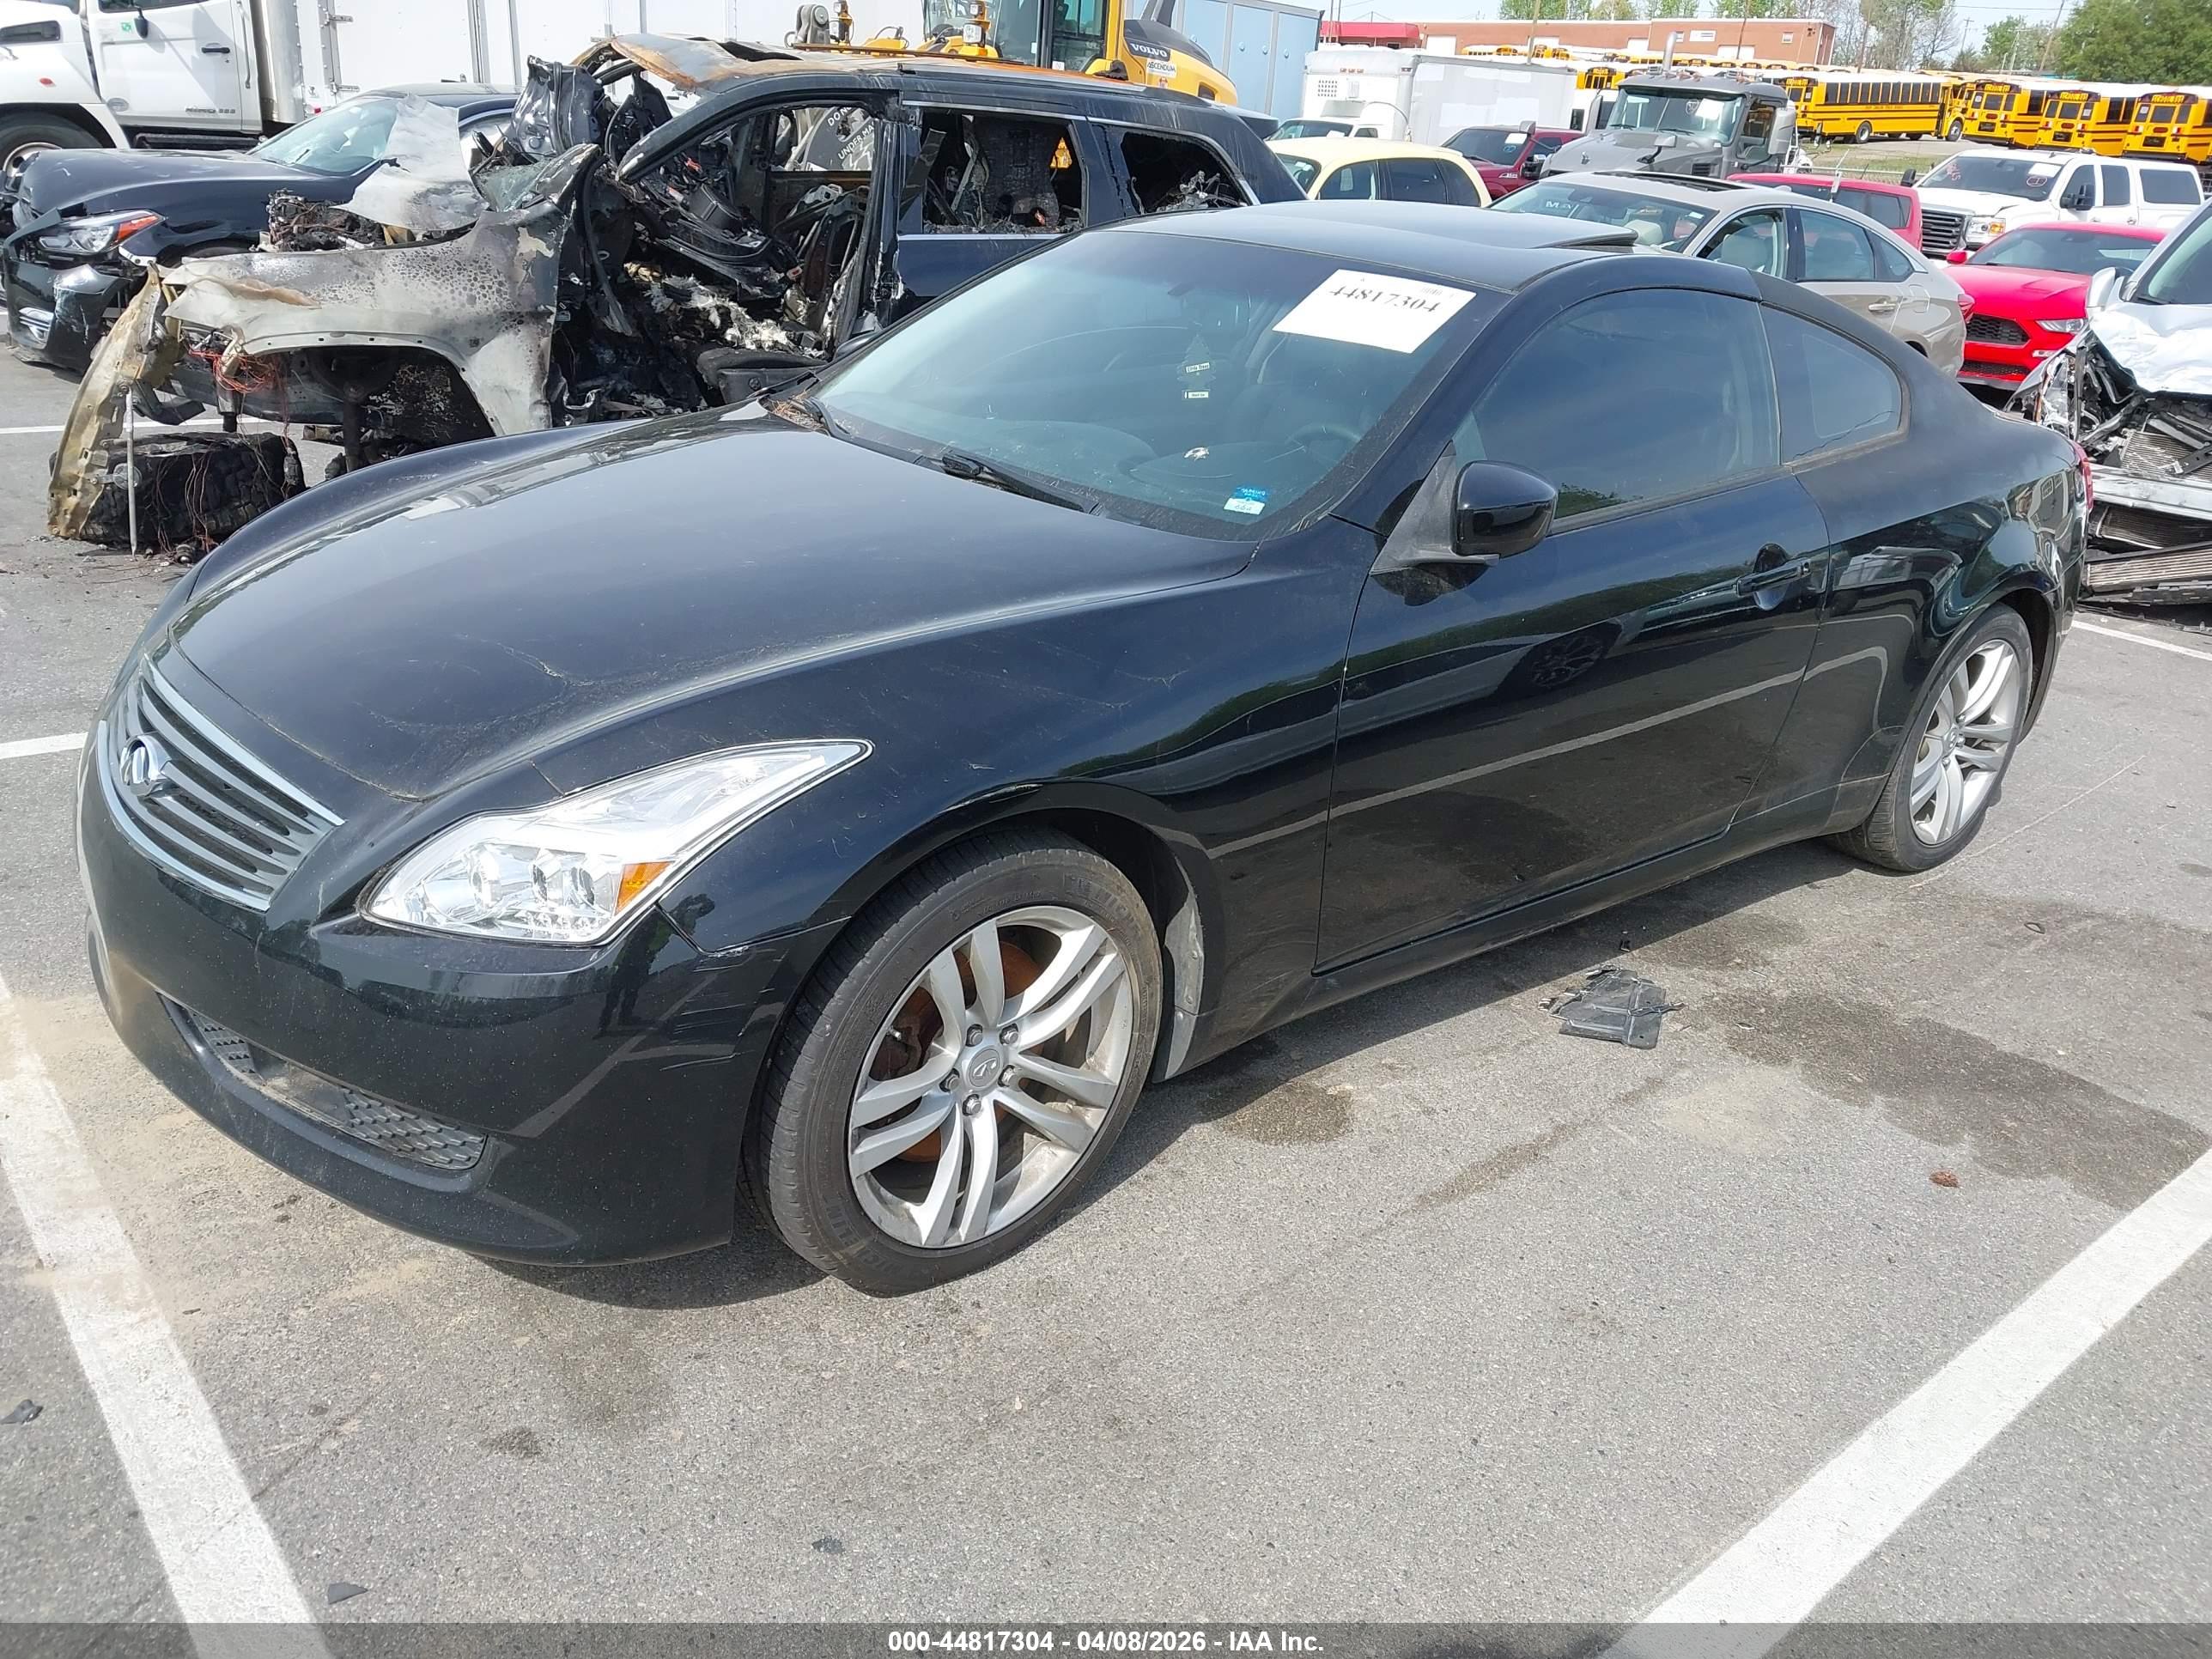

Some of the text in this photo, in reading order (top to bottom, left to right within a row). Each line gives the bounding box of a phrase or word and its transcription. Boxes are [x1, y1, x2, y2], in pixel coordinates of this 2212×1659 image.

[1130, 43, 1168, 58] VOLVO
[1147, 61, 1176, 73] ASCENDUM
[827, 112, 841, 126] DO
[837, 135, 863, 160] UNDER
[1328, 286, 1440, 313] 44817304
